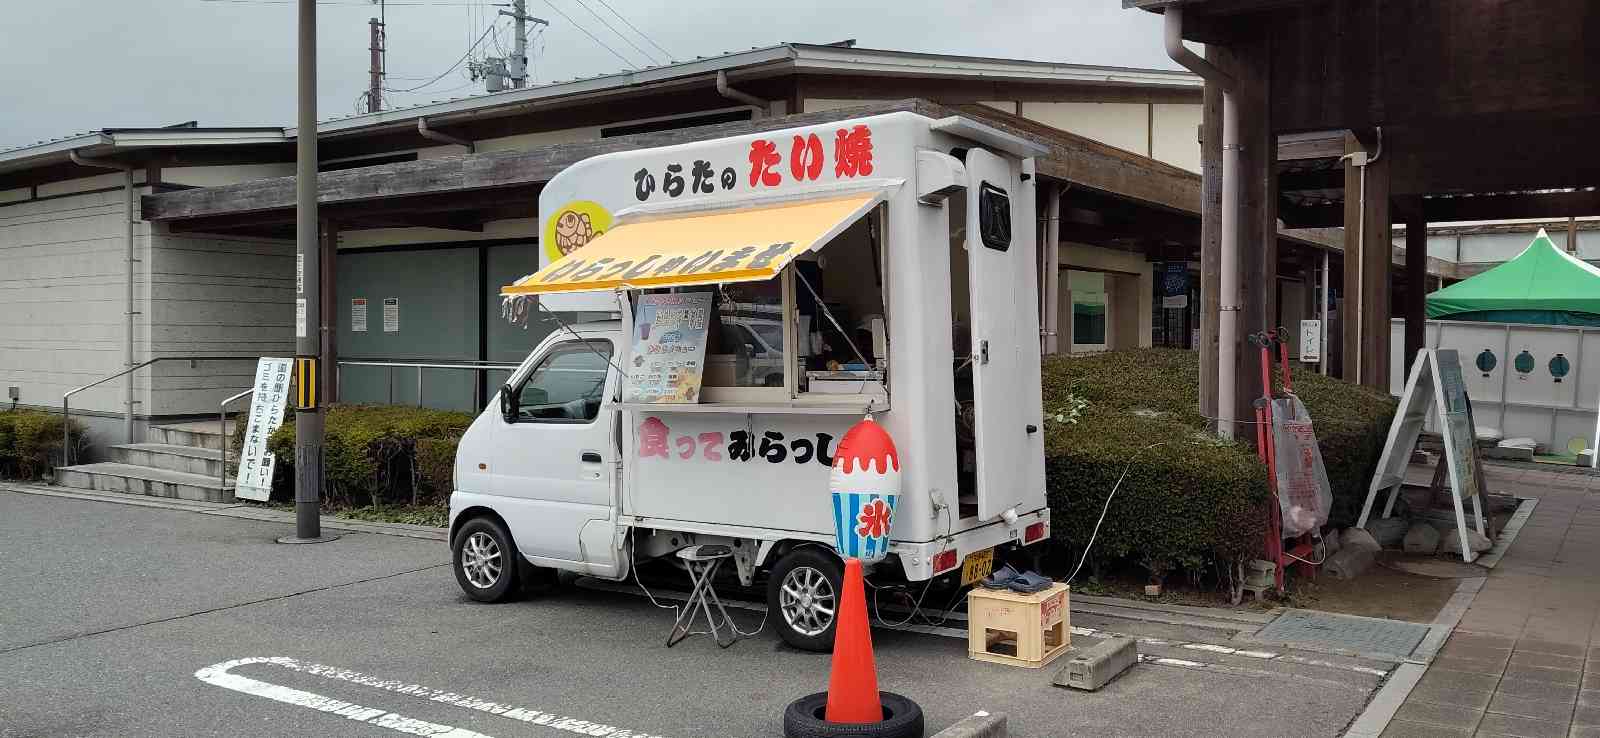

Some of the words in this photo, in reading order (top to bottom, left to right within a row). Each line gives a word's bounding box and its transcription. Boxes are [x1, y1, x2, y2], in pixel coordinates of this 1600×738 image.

[633, 158, 738, 202] ひらたの
[748, 123, 874, 188] たい焼
[541, 241, 794, 283] いらっしゃいませ
[857, 498, 893, 539] 氷
